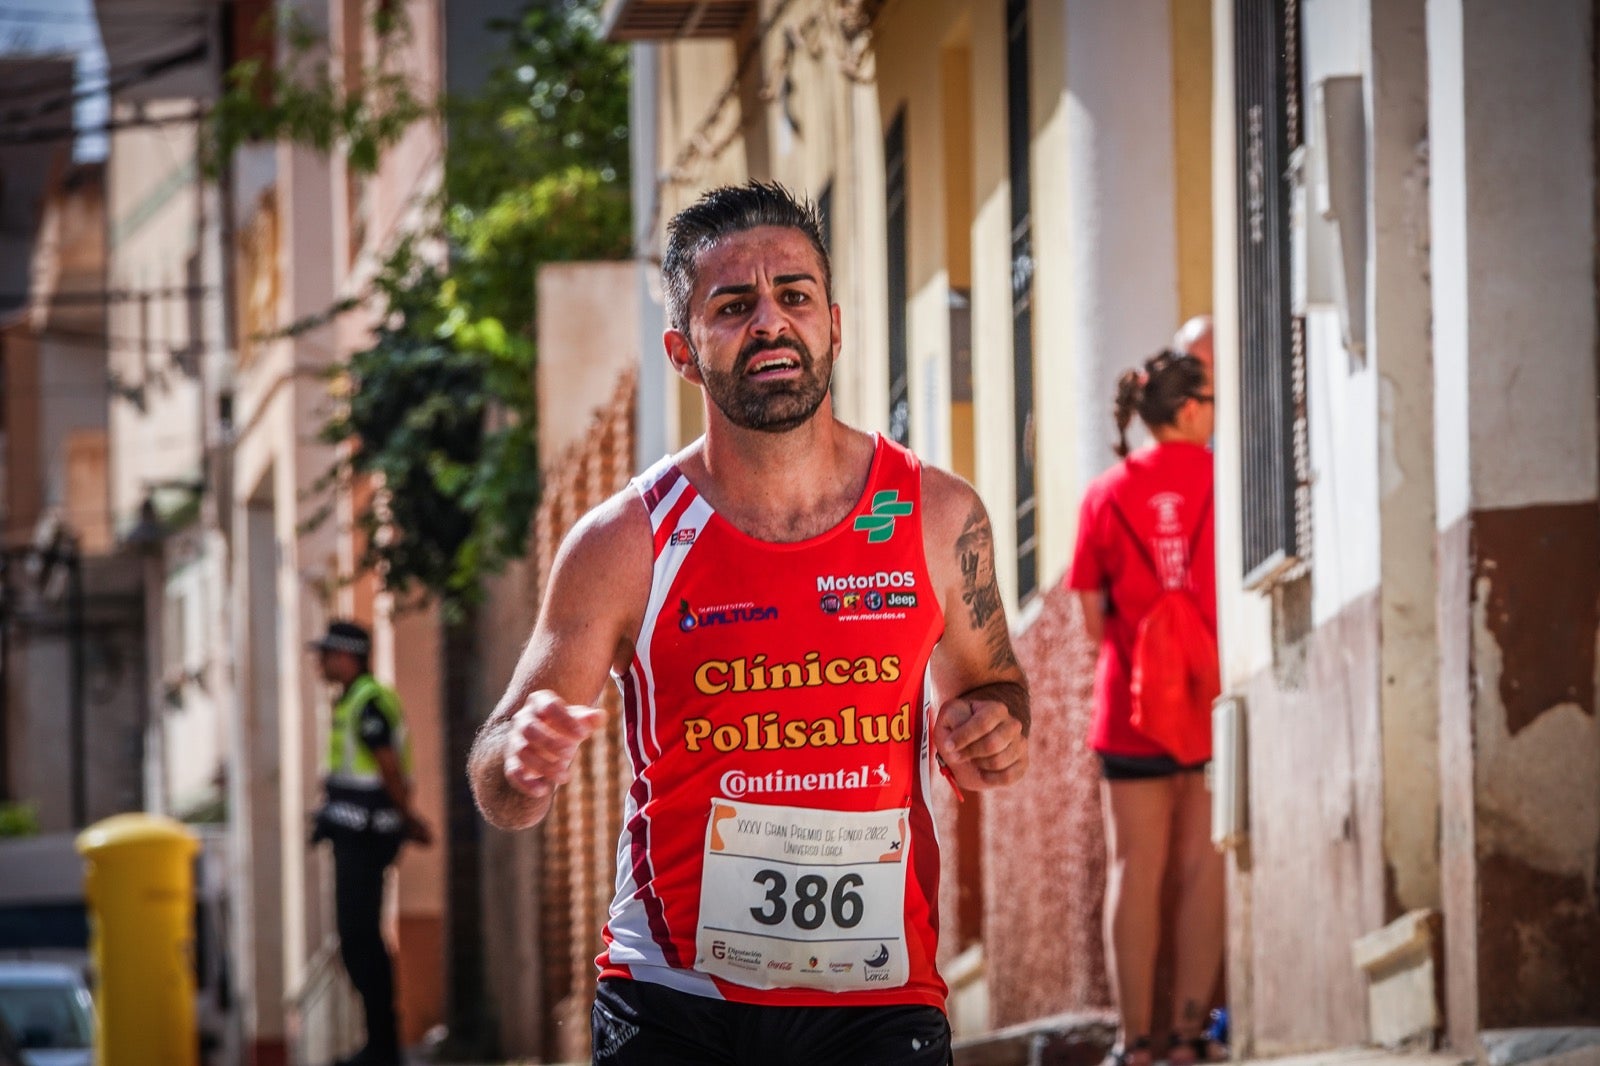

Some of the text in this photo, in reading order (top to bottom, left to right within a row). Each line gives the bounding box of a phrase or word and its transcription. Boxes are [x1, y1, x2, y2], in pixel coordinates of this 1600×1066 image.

[817, 571, 915, 592] MotorDOS
[888, 593, 916, 607] Jeep
[838, 612, 906, 621] www.motordos.es
[694, 651, 901, 695] Clínicas
[683, 703, 912, 752] Polisalud
[720, 765, 869, 798] Continental
[737, 819, 762, 835] XXXV
[865, 826, 888, 840] 2022
[750, 869, 865, 930] 386
